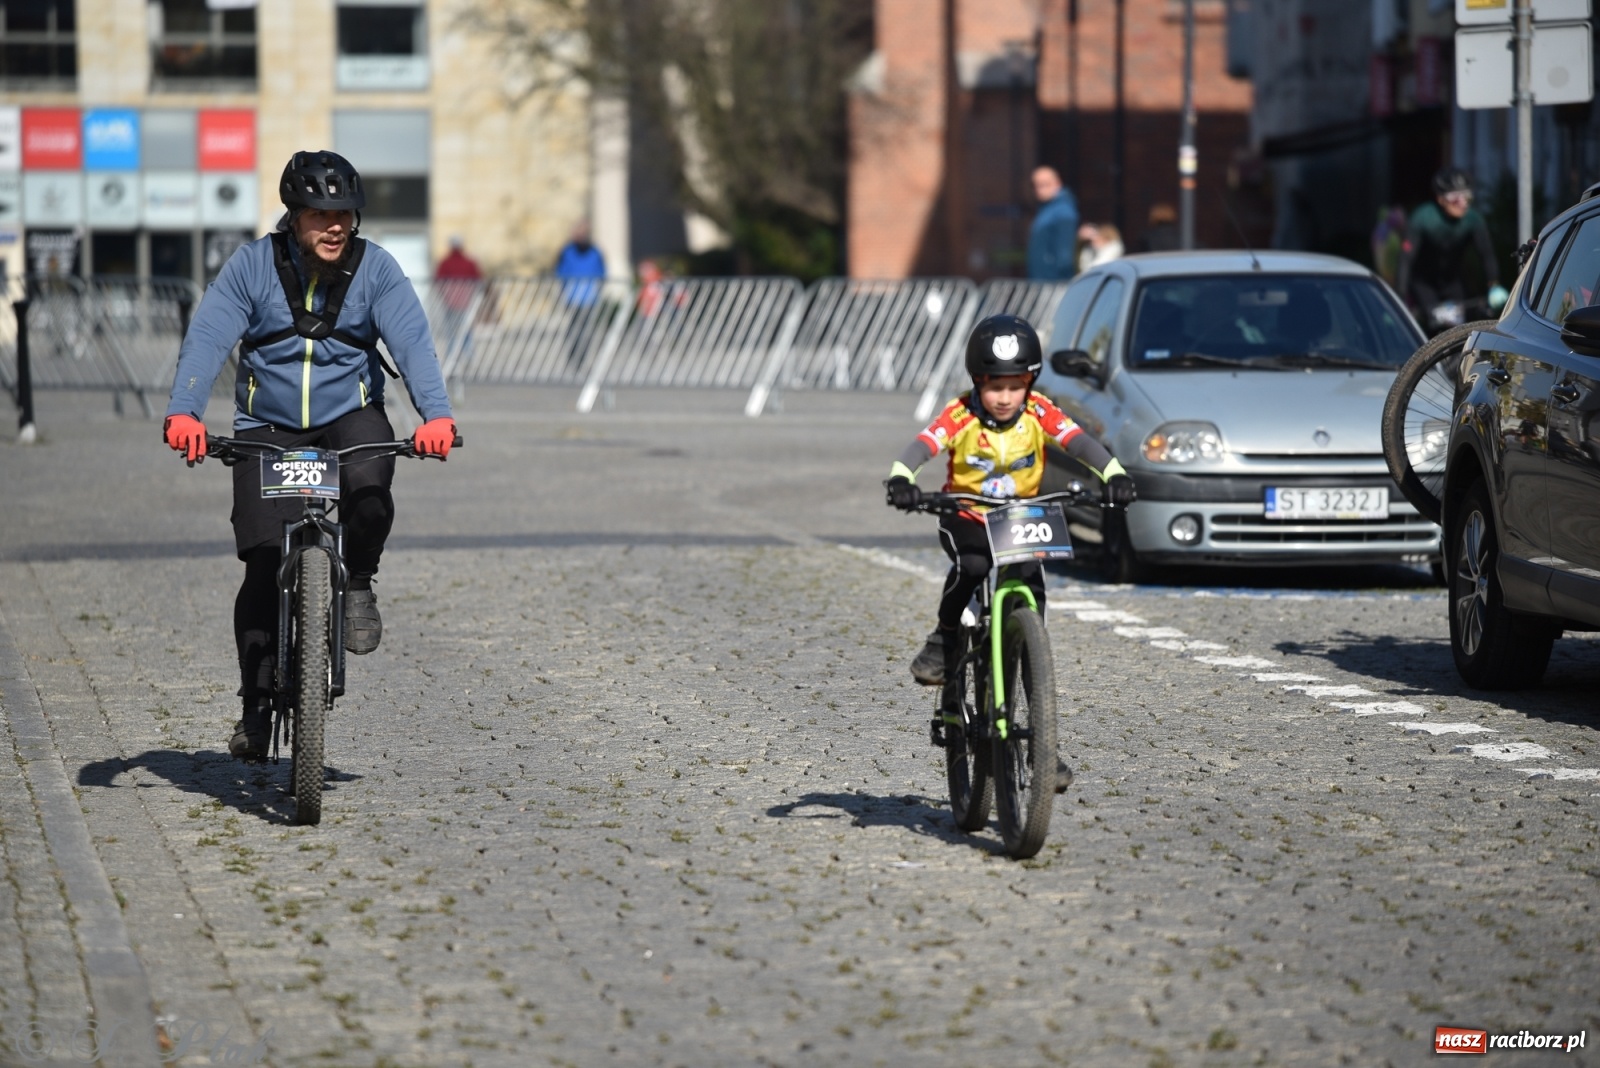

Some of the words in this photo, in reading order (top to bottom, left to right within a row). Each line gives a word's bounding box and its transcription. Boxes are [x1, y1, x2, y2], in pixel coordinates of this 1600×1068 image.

[272, 461, 327, 472] OPIEKUN
[281, 470, 322, 486] 220
[1280, 490, 1309, 511] ST
[1318, 490, 1383, 512] 3232J
[1010, 522, 1053, 545] 220
